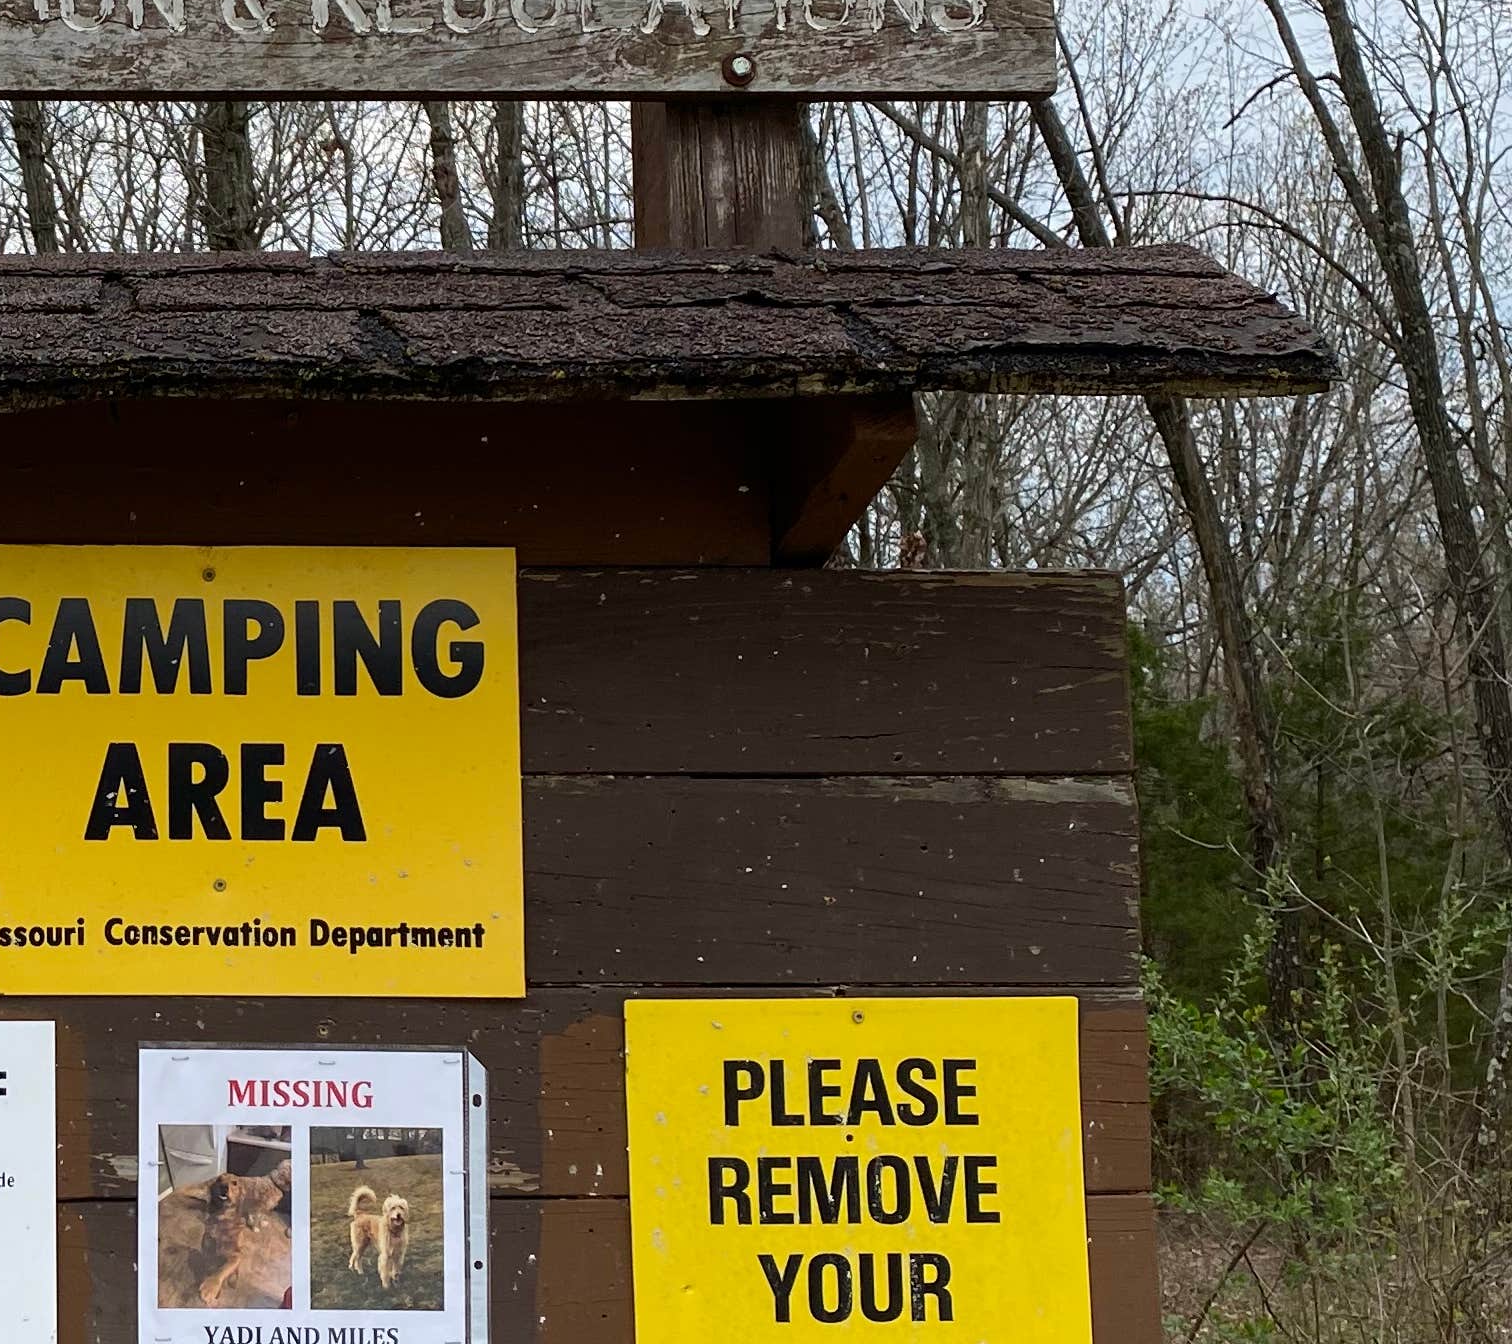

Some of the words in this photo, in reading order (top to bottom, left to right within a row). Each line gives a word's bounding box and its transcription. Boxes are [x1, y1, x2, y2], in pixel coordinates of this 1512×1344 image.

[84, 743, 366, 841] AREA
[105, 918, 296, 947] Conservation
[311, 919, 485, 954] Department
[228, 1080, 373, 1108] MISSING
[724, 1058, 979, 1126] PLEASE
[708, 1155, 1000, 1225] REMOVE
[757, 1253, 953, 1323] YOUR
[205, 1326, 261, 1344] YADI
[269, 1327, 319, 1344] AND
